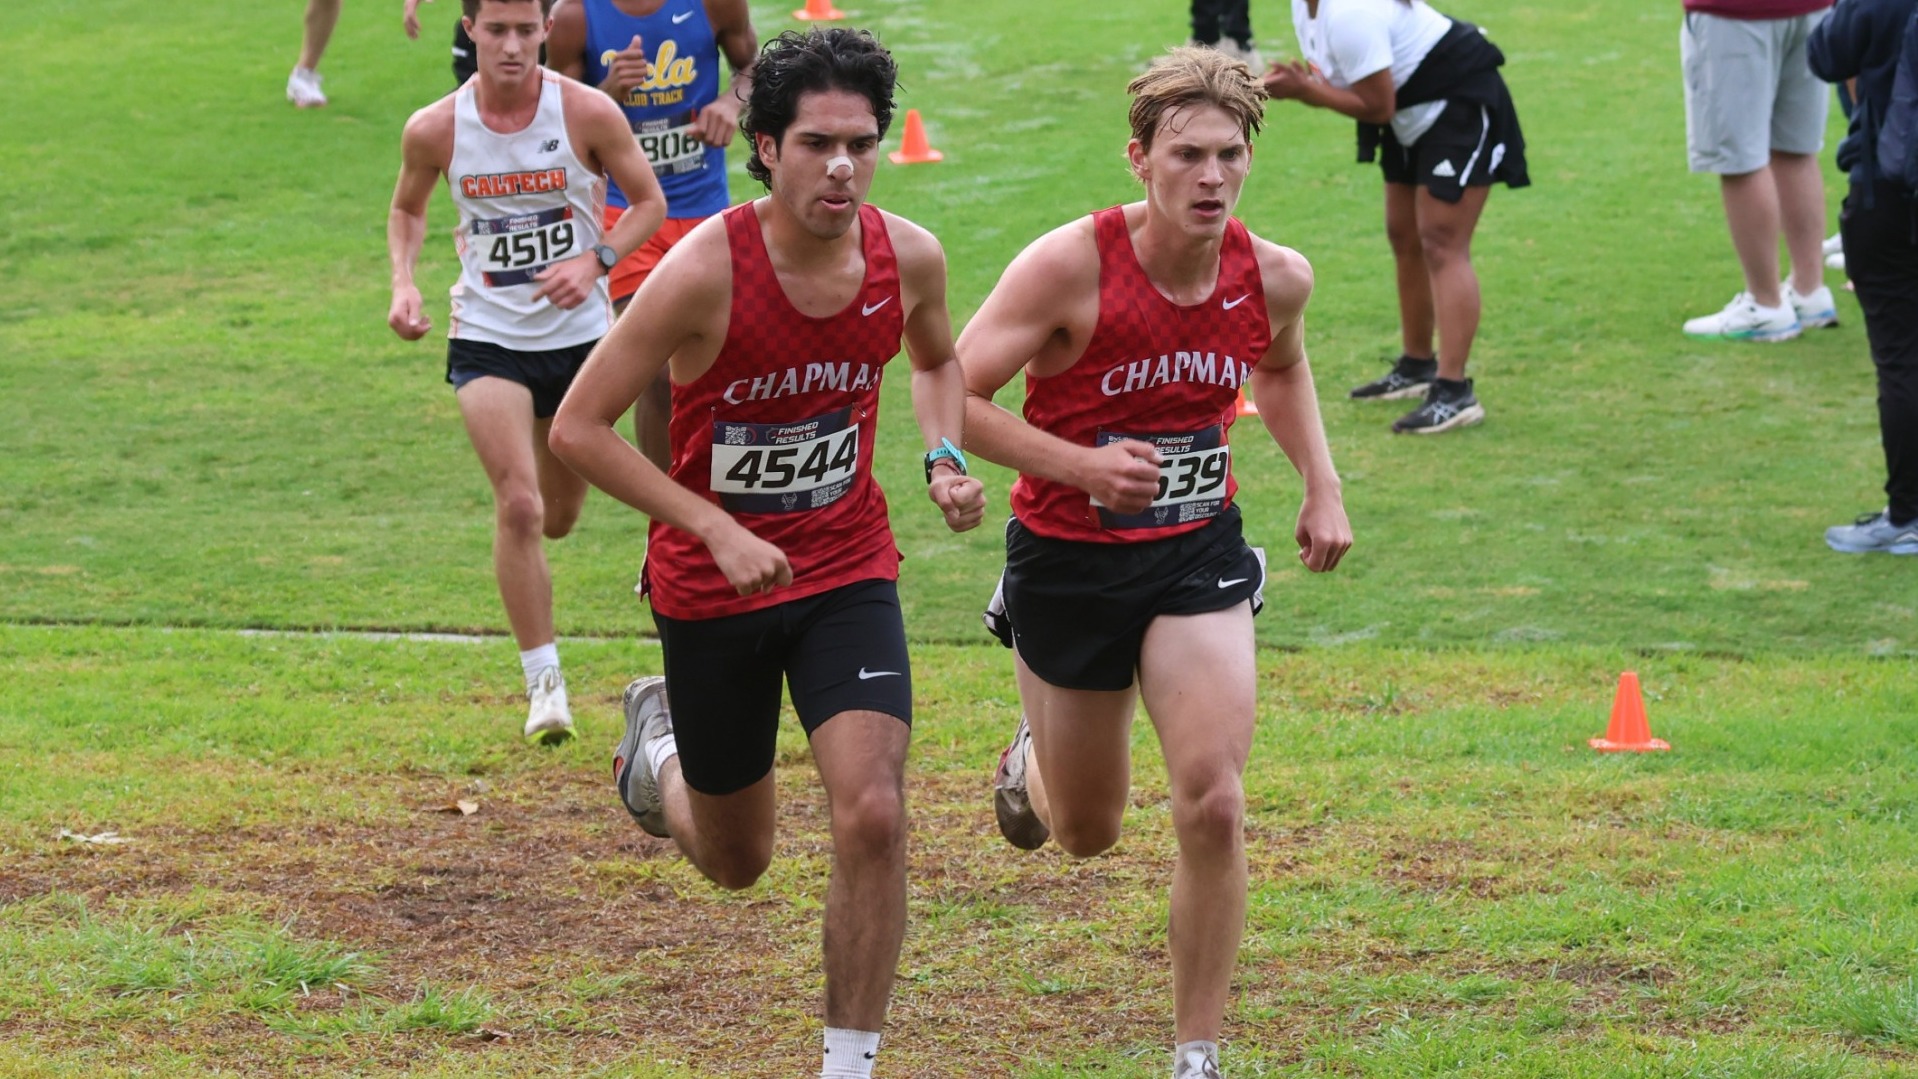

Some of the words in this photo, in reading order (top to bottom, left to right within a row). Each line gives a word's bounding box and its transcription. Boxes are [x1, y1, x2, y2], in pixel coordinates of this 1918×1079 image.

[650, 88, 684, 106] TRACK
[641, 132, 700, 162] 806
[459, 167, 568, 199] CALTECH
[489, 222, 574, 268] 4519
[775, 430, 817, 445] RESULTS
[778, 421, 819, 436] FINISHED
[1156, 435, 1195, 446] FINISHED
[725, 429, 858, 489] 4544
[1153, 451, 1228, 501] 539
